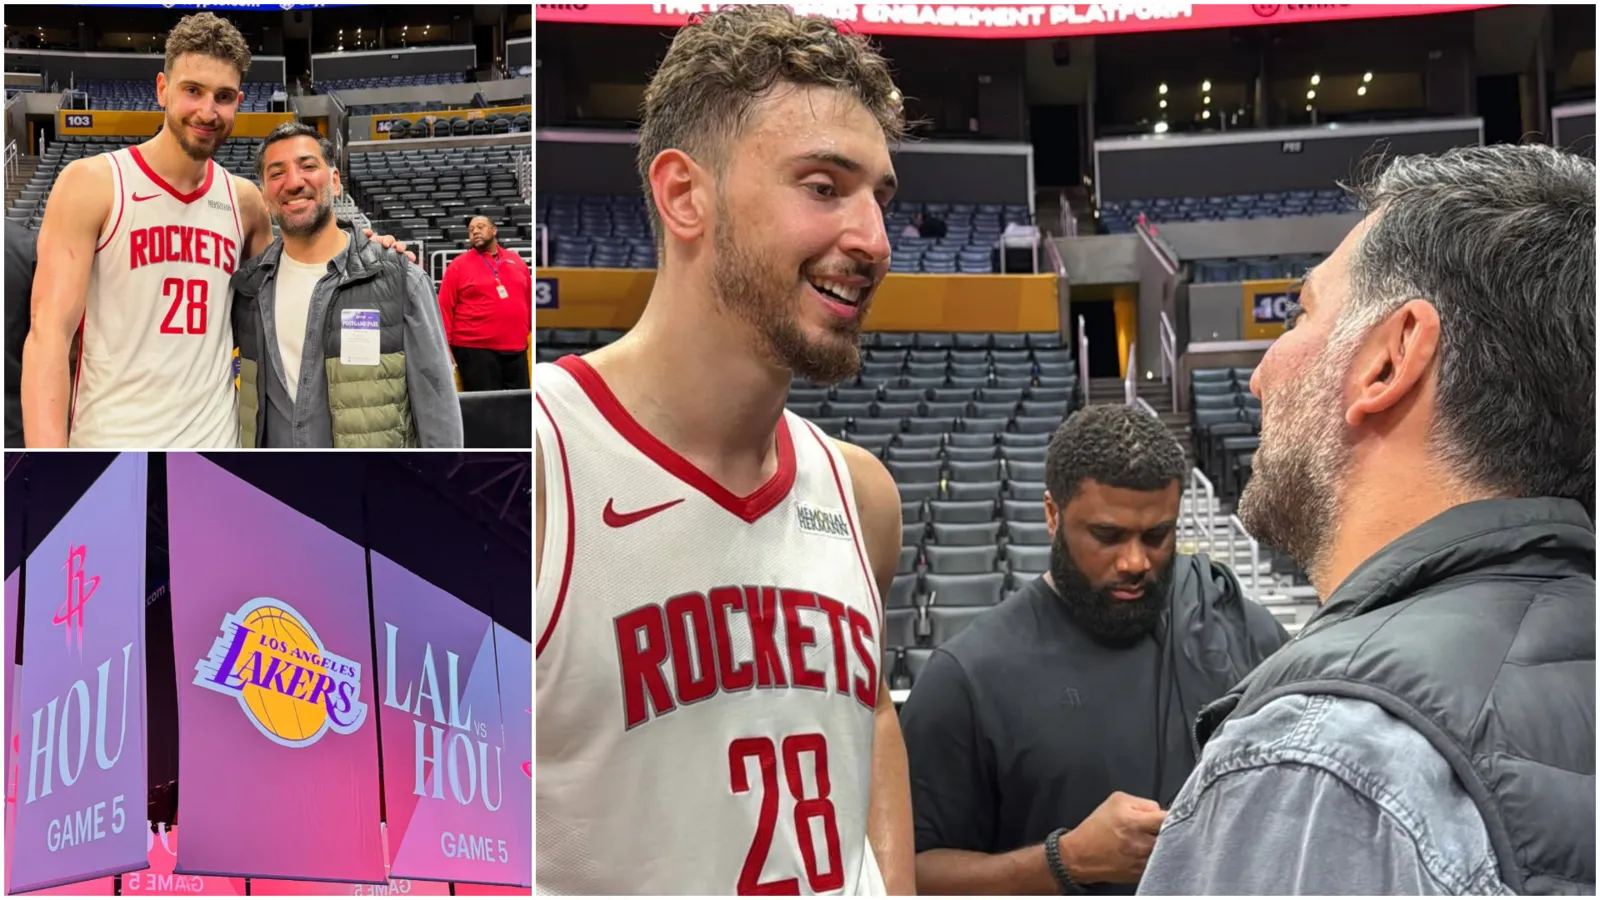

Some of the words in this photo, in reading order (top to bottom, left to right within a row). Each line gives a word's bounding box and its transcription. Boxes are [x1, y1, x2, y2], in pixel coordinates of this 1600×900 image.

[862, 4, 1046, 26] ENGAGEMENT
[1049, 4, 1192, 25] PLATFORM
[67, 115, 90, 126] 103
[130, 225, 236, 275] ROCKETS
[160, 277, 208, 334] 28
[204, 621, 362, 727] LAKERS
[259, 635, 288, 653] LOS
[289, 647, 355, 678] ANGELES
[384, 621, 472, 732] LAL
[613, 585, 877, 731] ROCKETS
[25, 642, 133, 804] HOU
[413, 719, 502, 812] HOU
[47, 801, 107, 852] GAME
[111, 795, 126, 834] 5
[728, 733, 845, 896] 28
[441, 831, 502, 862] GAME
[498, 840, 508, 863] 5
